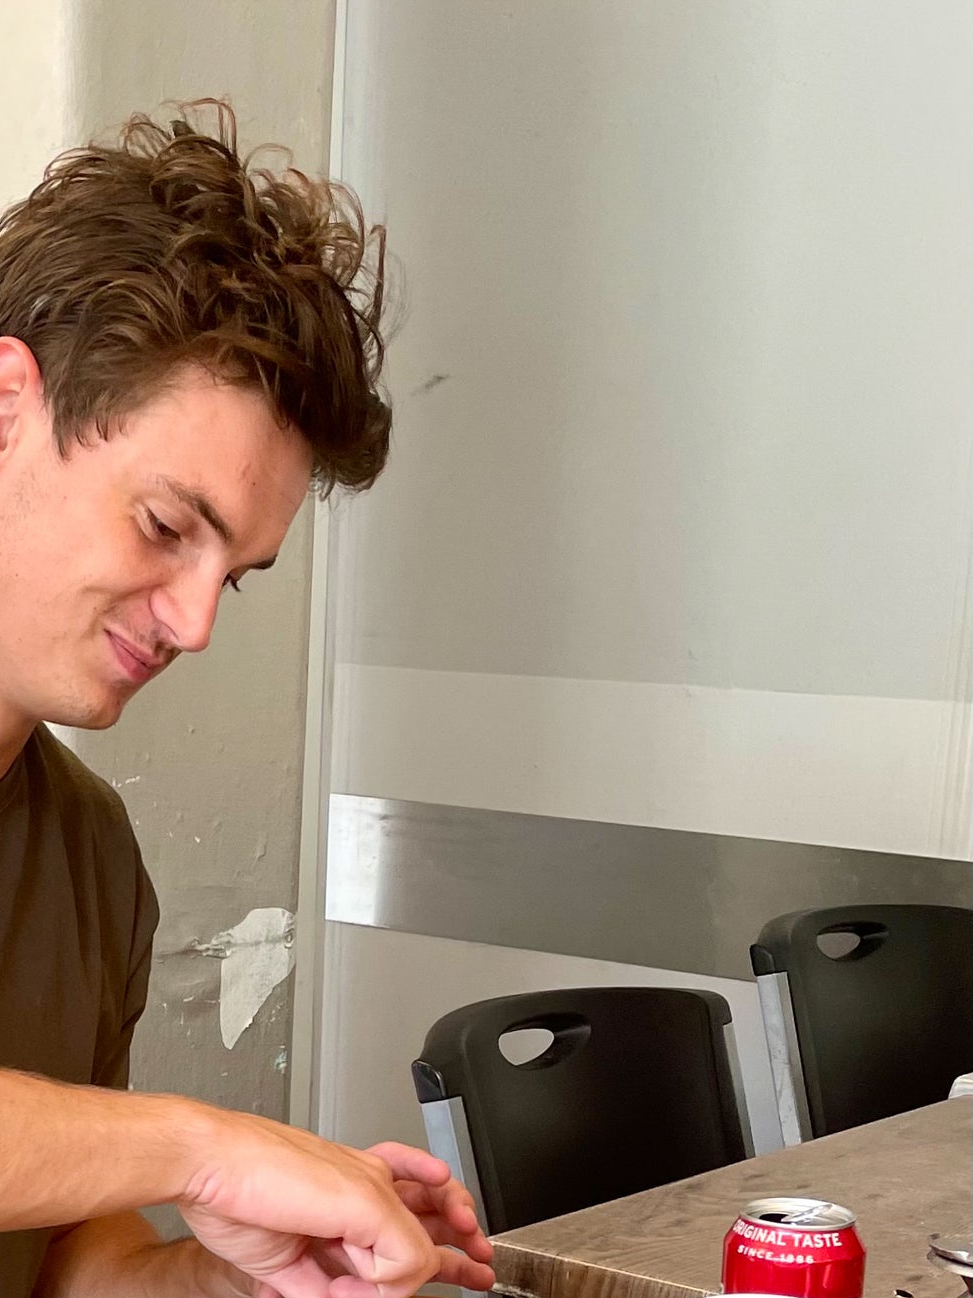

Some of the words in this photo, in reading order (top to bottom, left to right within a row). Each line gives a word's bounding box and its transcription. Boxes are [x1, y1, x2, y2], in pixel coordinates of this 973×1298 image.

[732, 1219, 786, 1246] ORIGINAL
[792, 1232, 842, 1248] TASTE
[737, 1245, 774, 1260] SINCE
[779, 1253, 815, 1265] 1886
